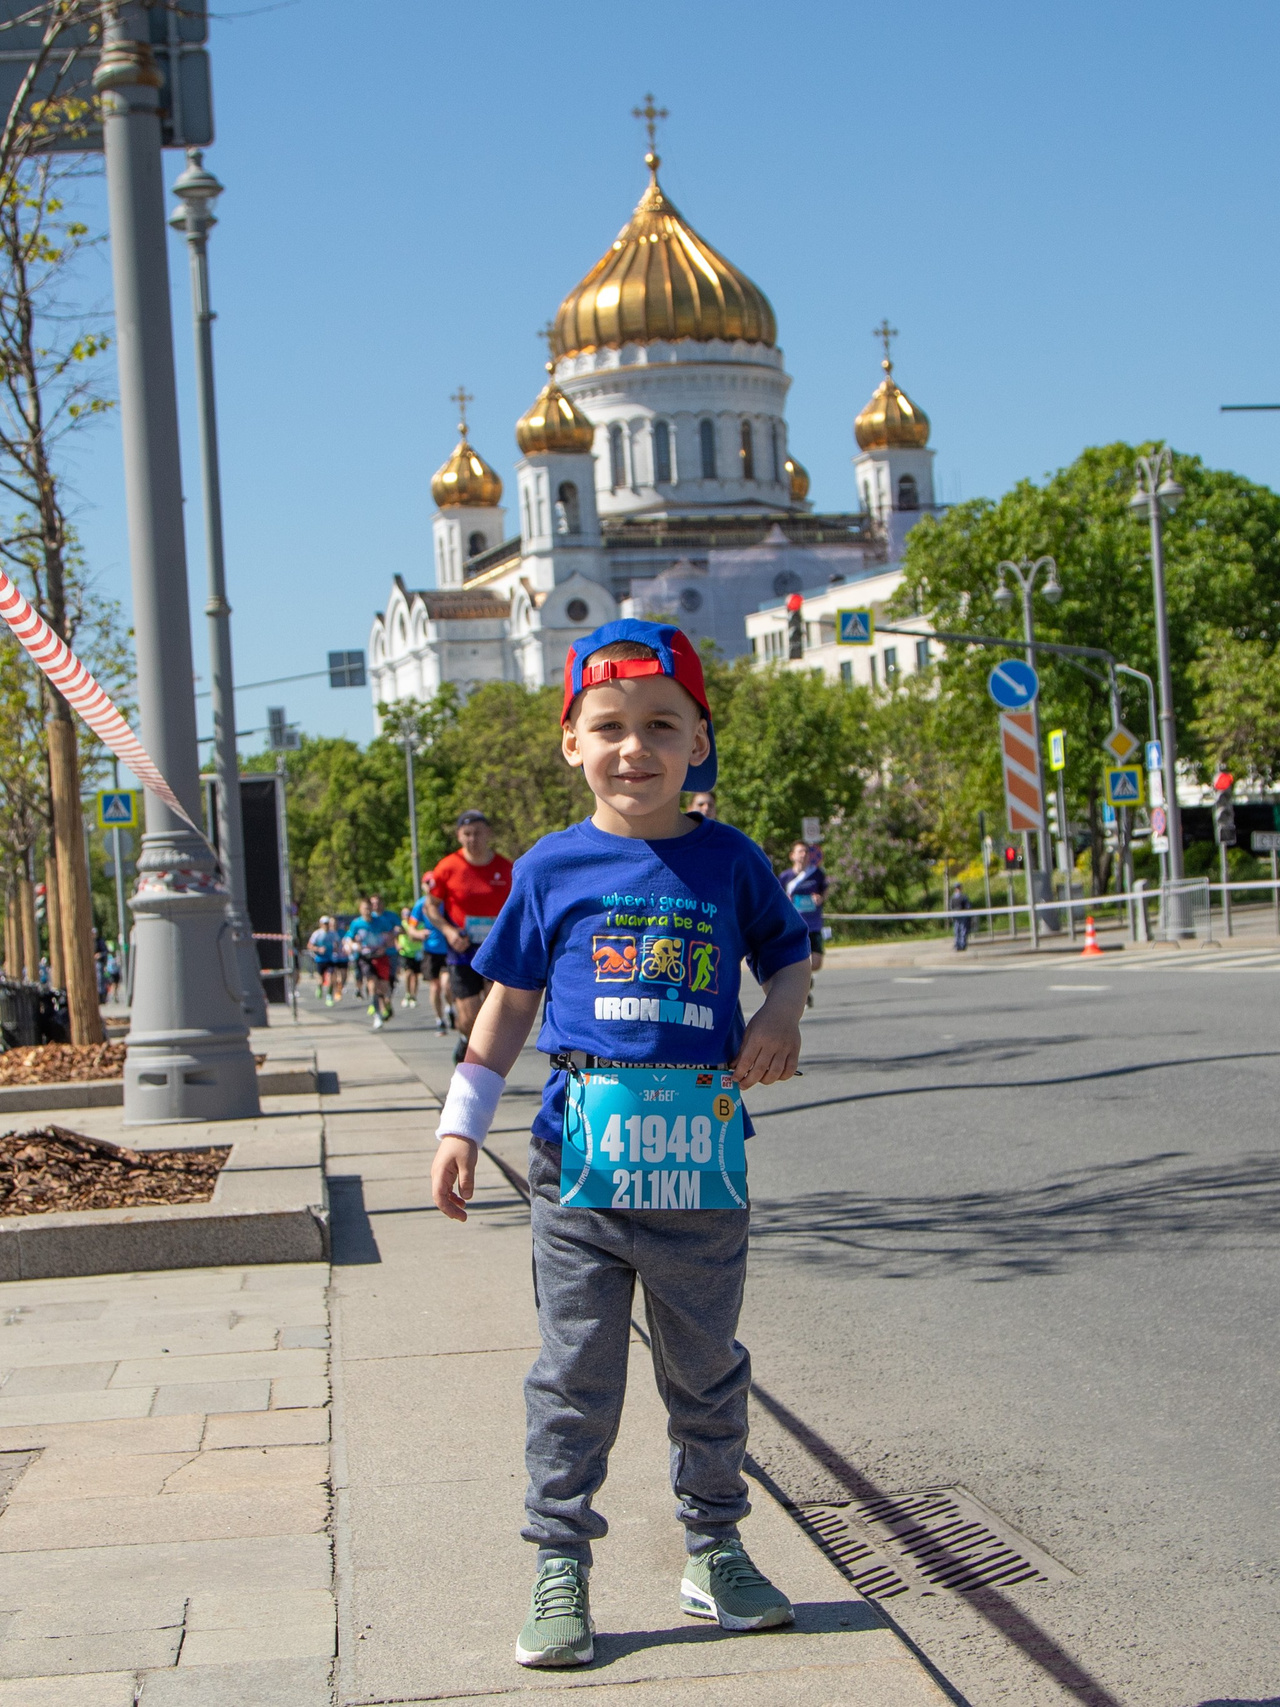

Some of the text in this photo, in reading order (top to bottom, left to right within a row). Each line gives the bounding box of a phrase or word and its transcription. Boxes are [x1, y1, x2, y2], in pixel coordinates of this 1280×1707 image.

[602, 892, 718, 918] when i grow up
[606, 911, 713, 934] i wanna be an
[594, 996, 714, 1030] IRONMAN
[592, 1074, 619, 1085] ПСБ
[719, 1099, 730, 1116] B
[600, 1114, 712, 1163] 41948
[611, 1168, 700, 1209] 21.1KM
